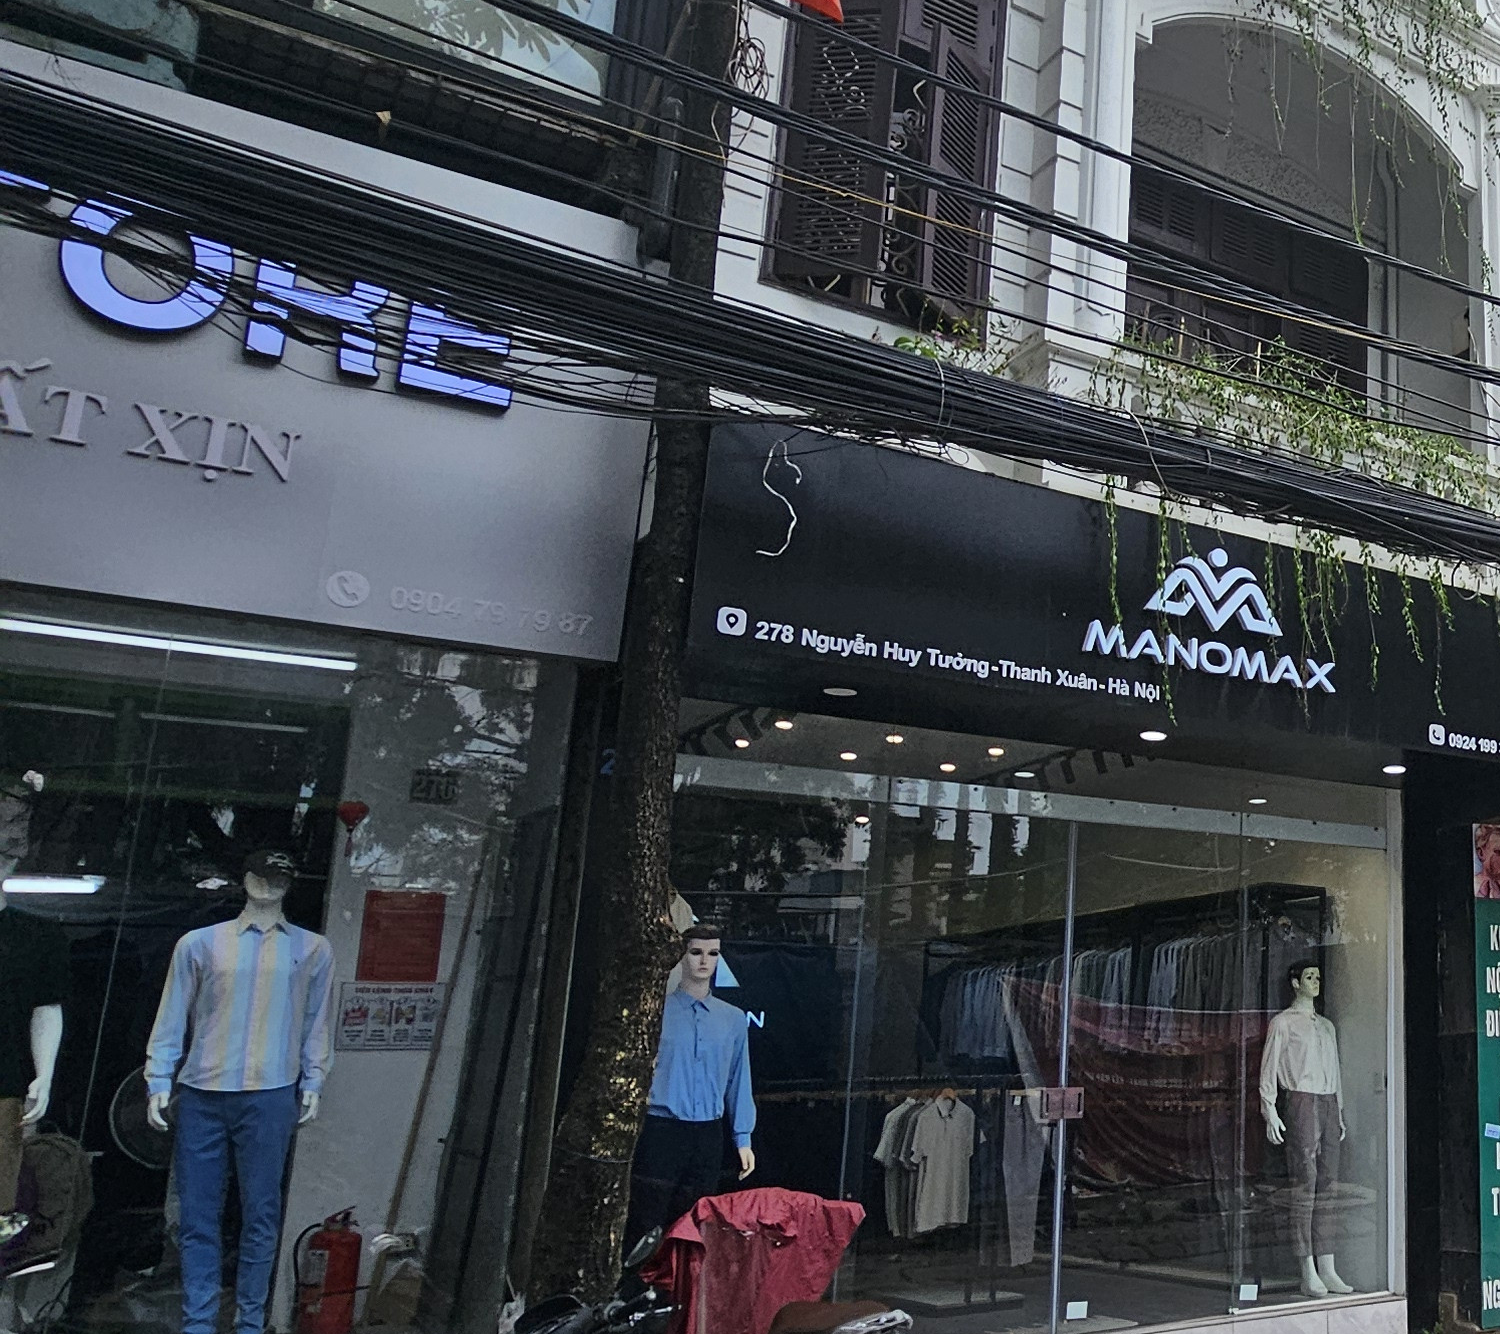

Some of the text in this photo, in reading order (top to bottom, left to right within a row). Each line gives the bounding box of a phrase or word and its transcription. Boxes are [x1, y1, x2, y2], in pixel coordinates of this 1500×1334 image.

[123, 400, 302, 481] XỊN
[754, 621, 795, 644] 278
[801, 628, 877, 657] Nguyễn
[883, 641, 922, 667] Huy
[1055, 668, 1097, 691] Xuân
[1081, 619, 1337, 693] MANOMAX
[1448, 733, 1477, 751] 0924
[1478, 738, 1497, 754] 199
